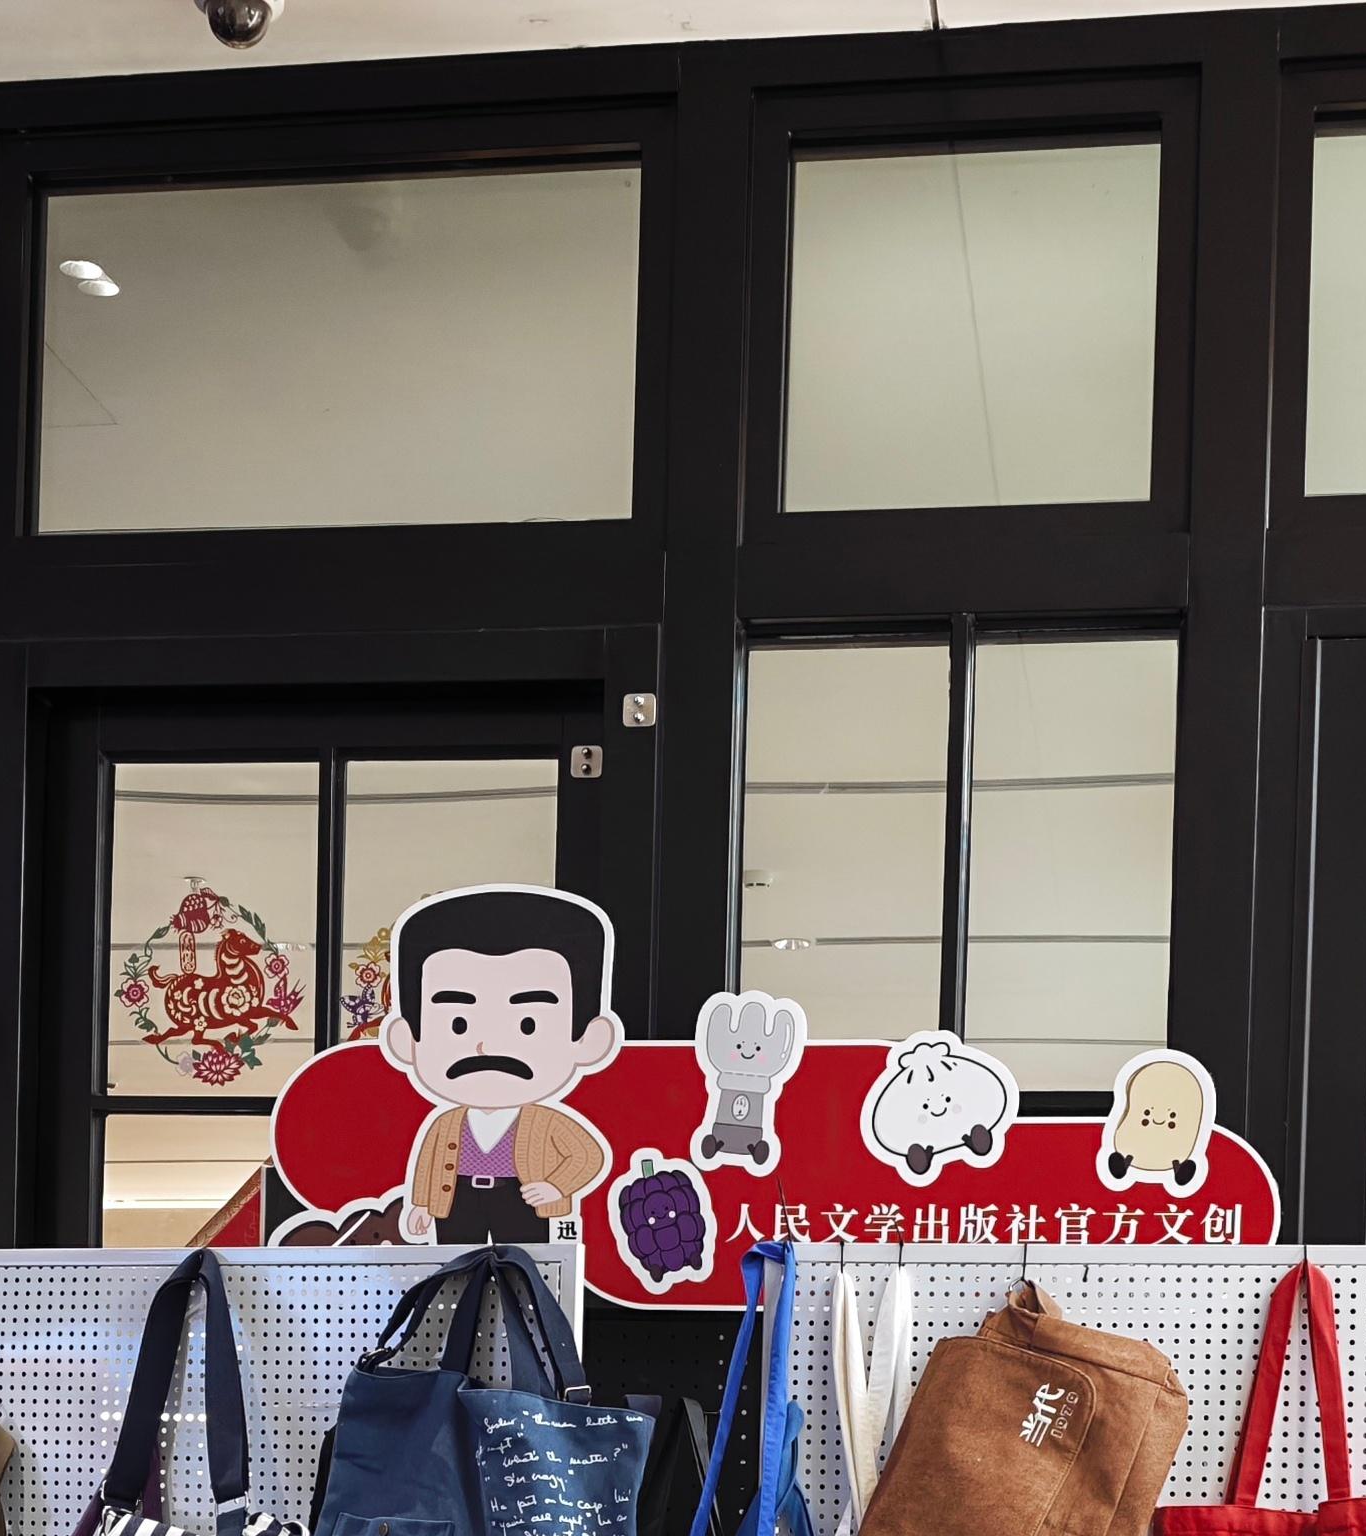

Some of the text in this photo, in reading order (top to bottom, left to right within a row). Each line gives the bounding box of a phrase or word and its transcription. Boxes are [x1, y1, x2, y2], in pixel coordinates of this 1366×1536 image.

[557, 1221, 578, 1241] 迅
[725, 1203, 1243, 1244] 人民文学出版社官方文创
